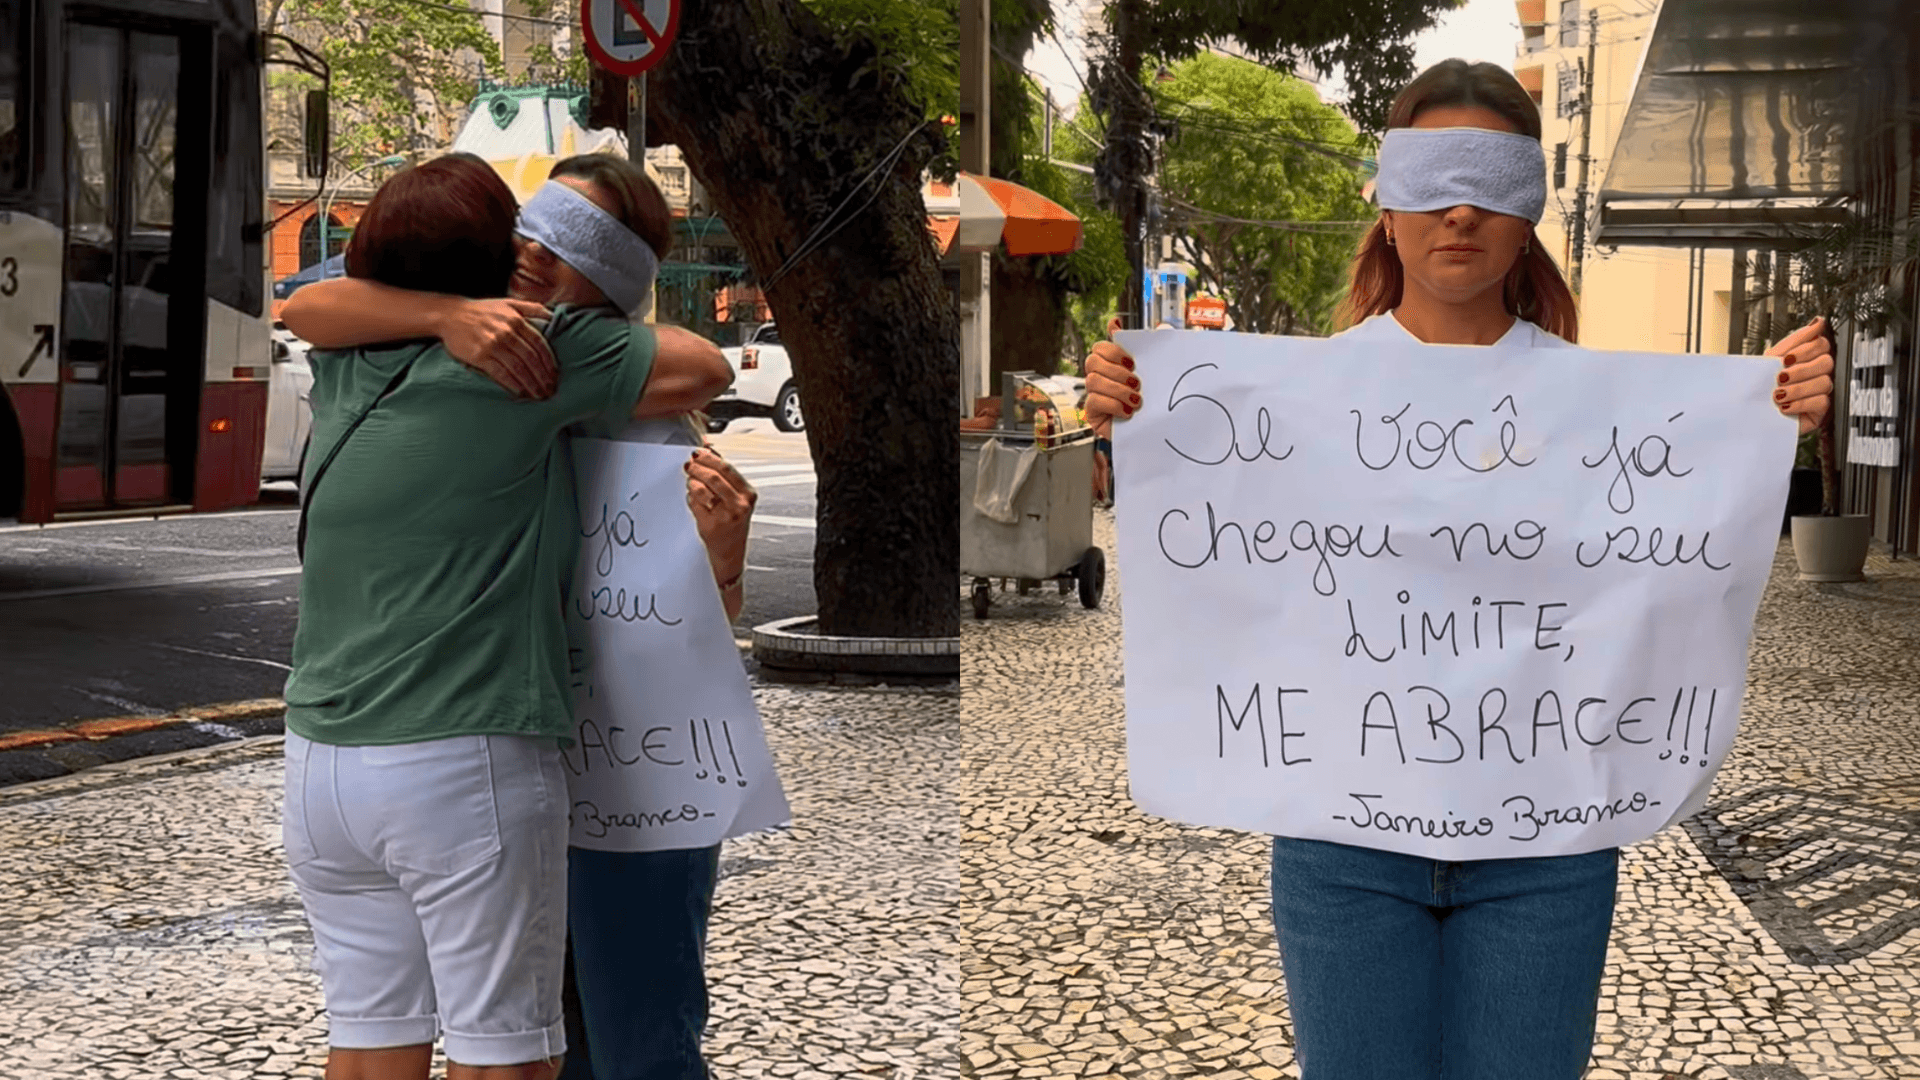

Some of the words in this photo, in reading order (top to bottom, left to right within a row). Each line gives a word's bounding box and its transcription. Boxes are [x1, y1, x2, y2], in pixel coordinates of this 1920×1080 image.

[1165, 363, 1293, 465] Se
[1582, 411, 1694, 514] já
[580, 492, 649, 577] já
[1430, 519, 1546, 562] no
[1576, 524, 1731, 570] seu
[576, 586, 683, 626] seu
[1217, 682, 1312, 768] ME
[1355, 685, 1717, 768] ABRACE!!!
